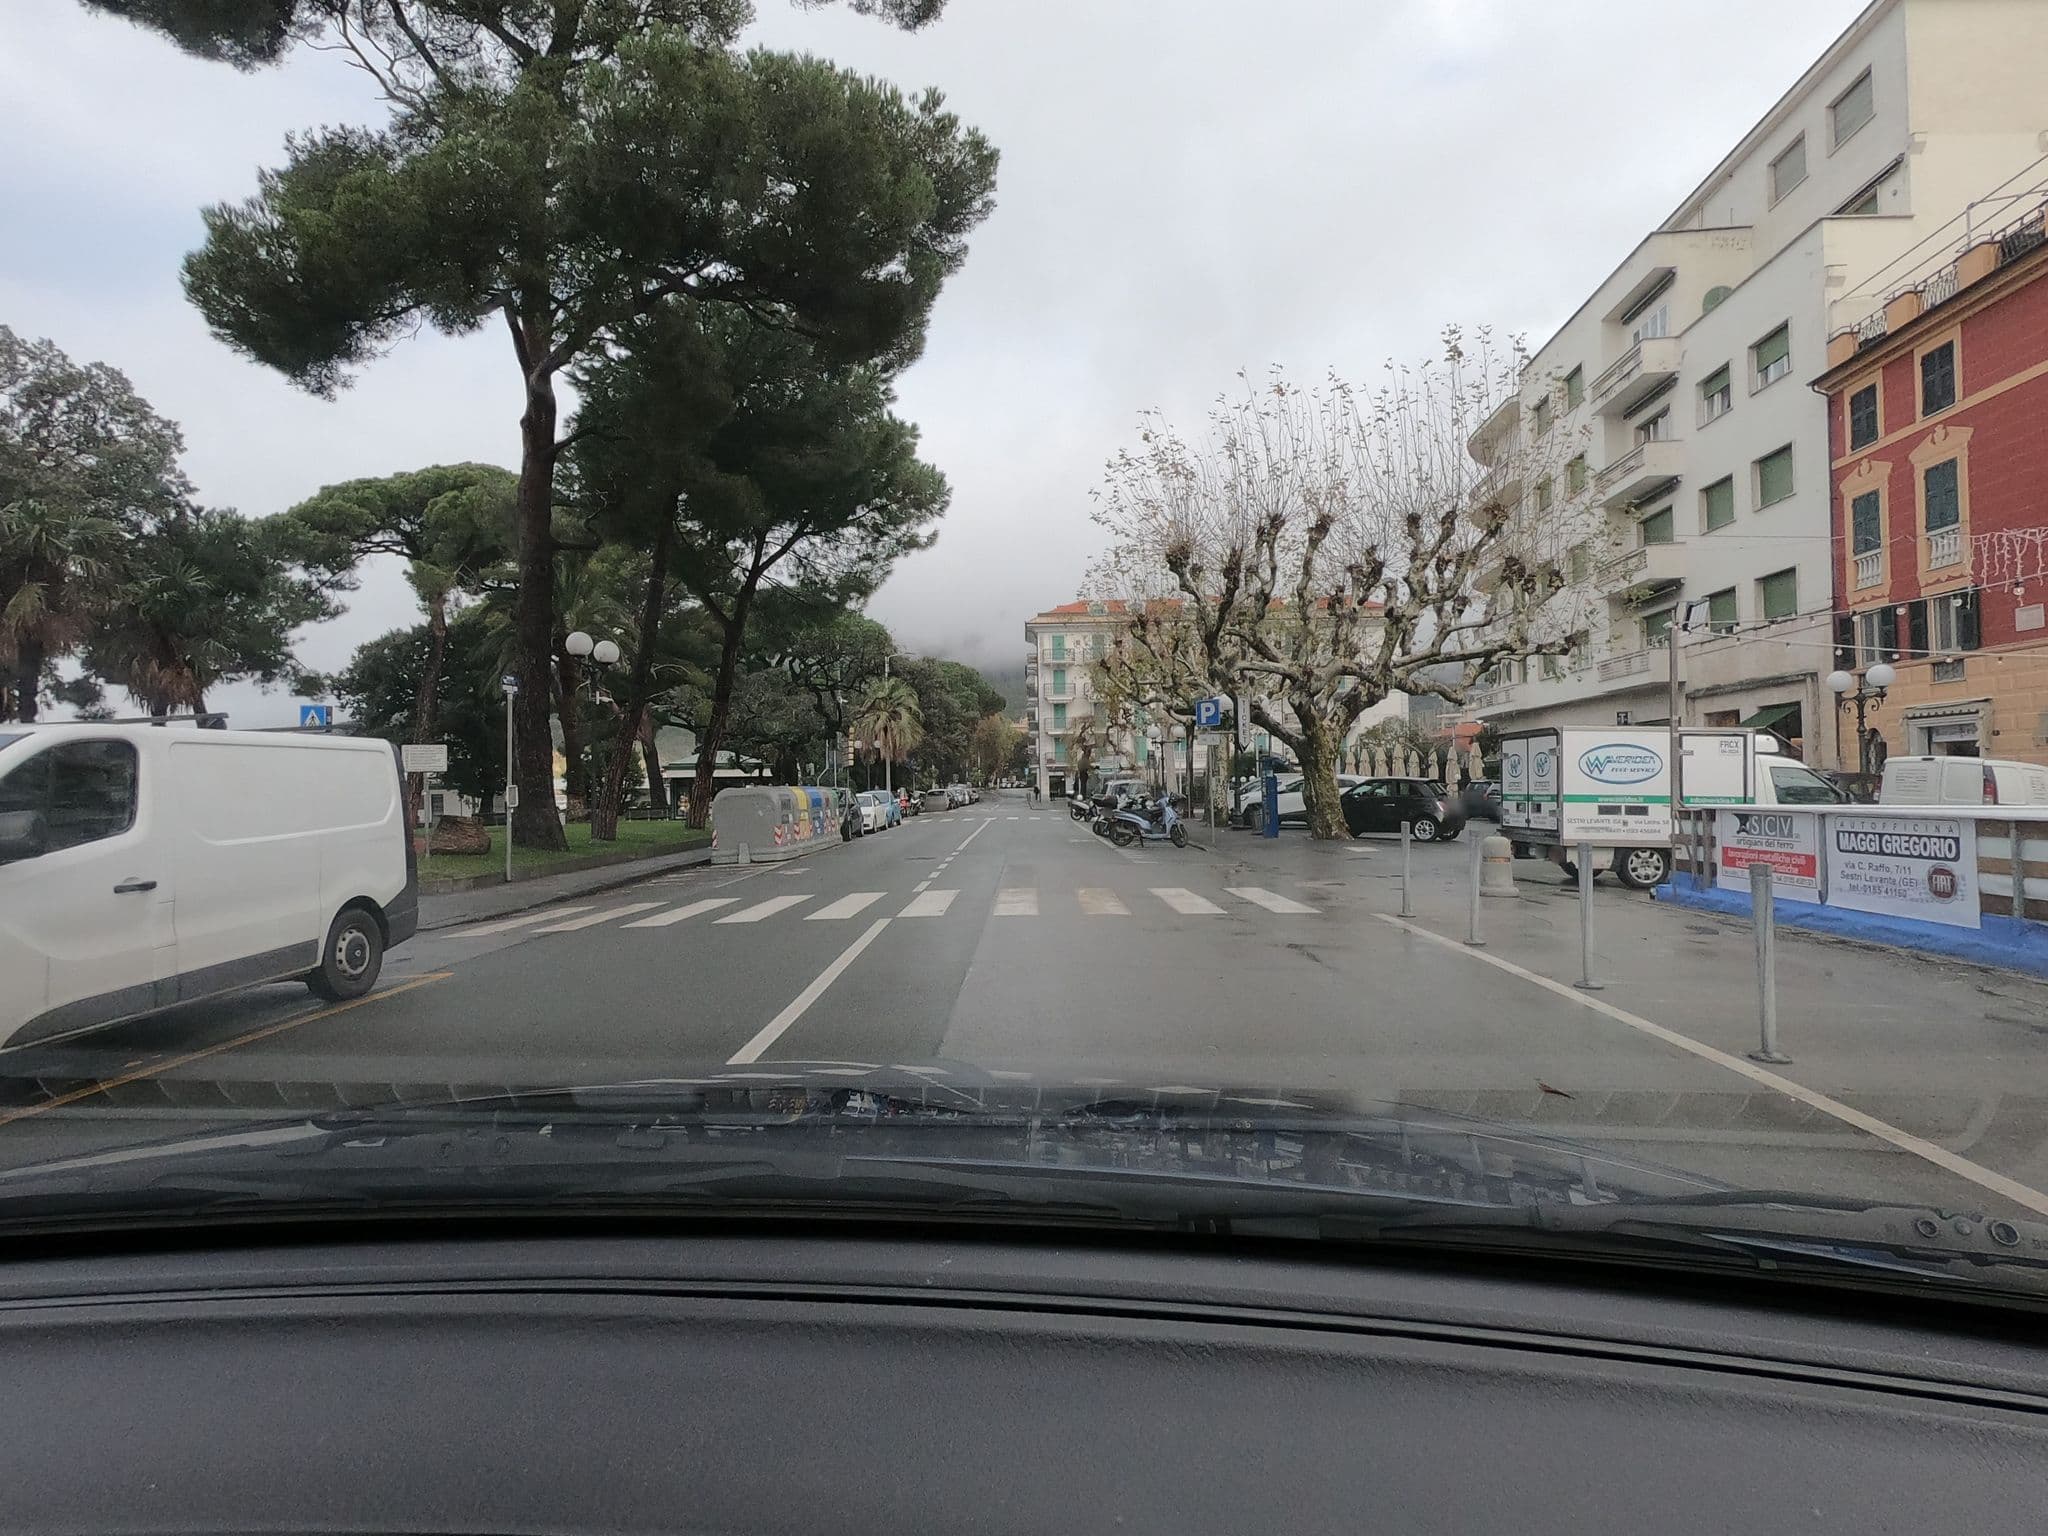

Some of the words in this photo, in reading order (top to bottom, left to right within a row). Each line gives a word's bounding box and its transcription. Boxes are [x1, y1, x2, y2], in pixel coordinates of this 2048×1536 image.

[1201, 702, 1216, 724] P
[1840, 821, 1954, 833] AUTOFFICINA
[1840, 832, 1880, 853] MAGGI
[1882, 834, 1956, 859] GREGORIO
